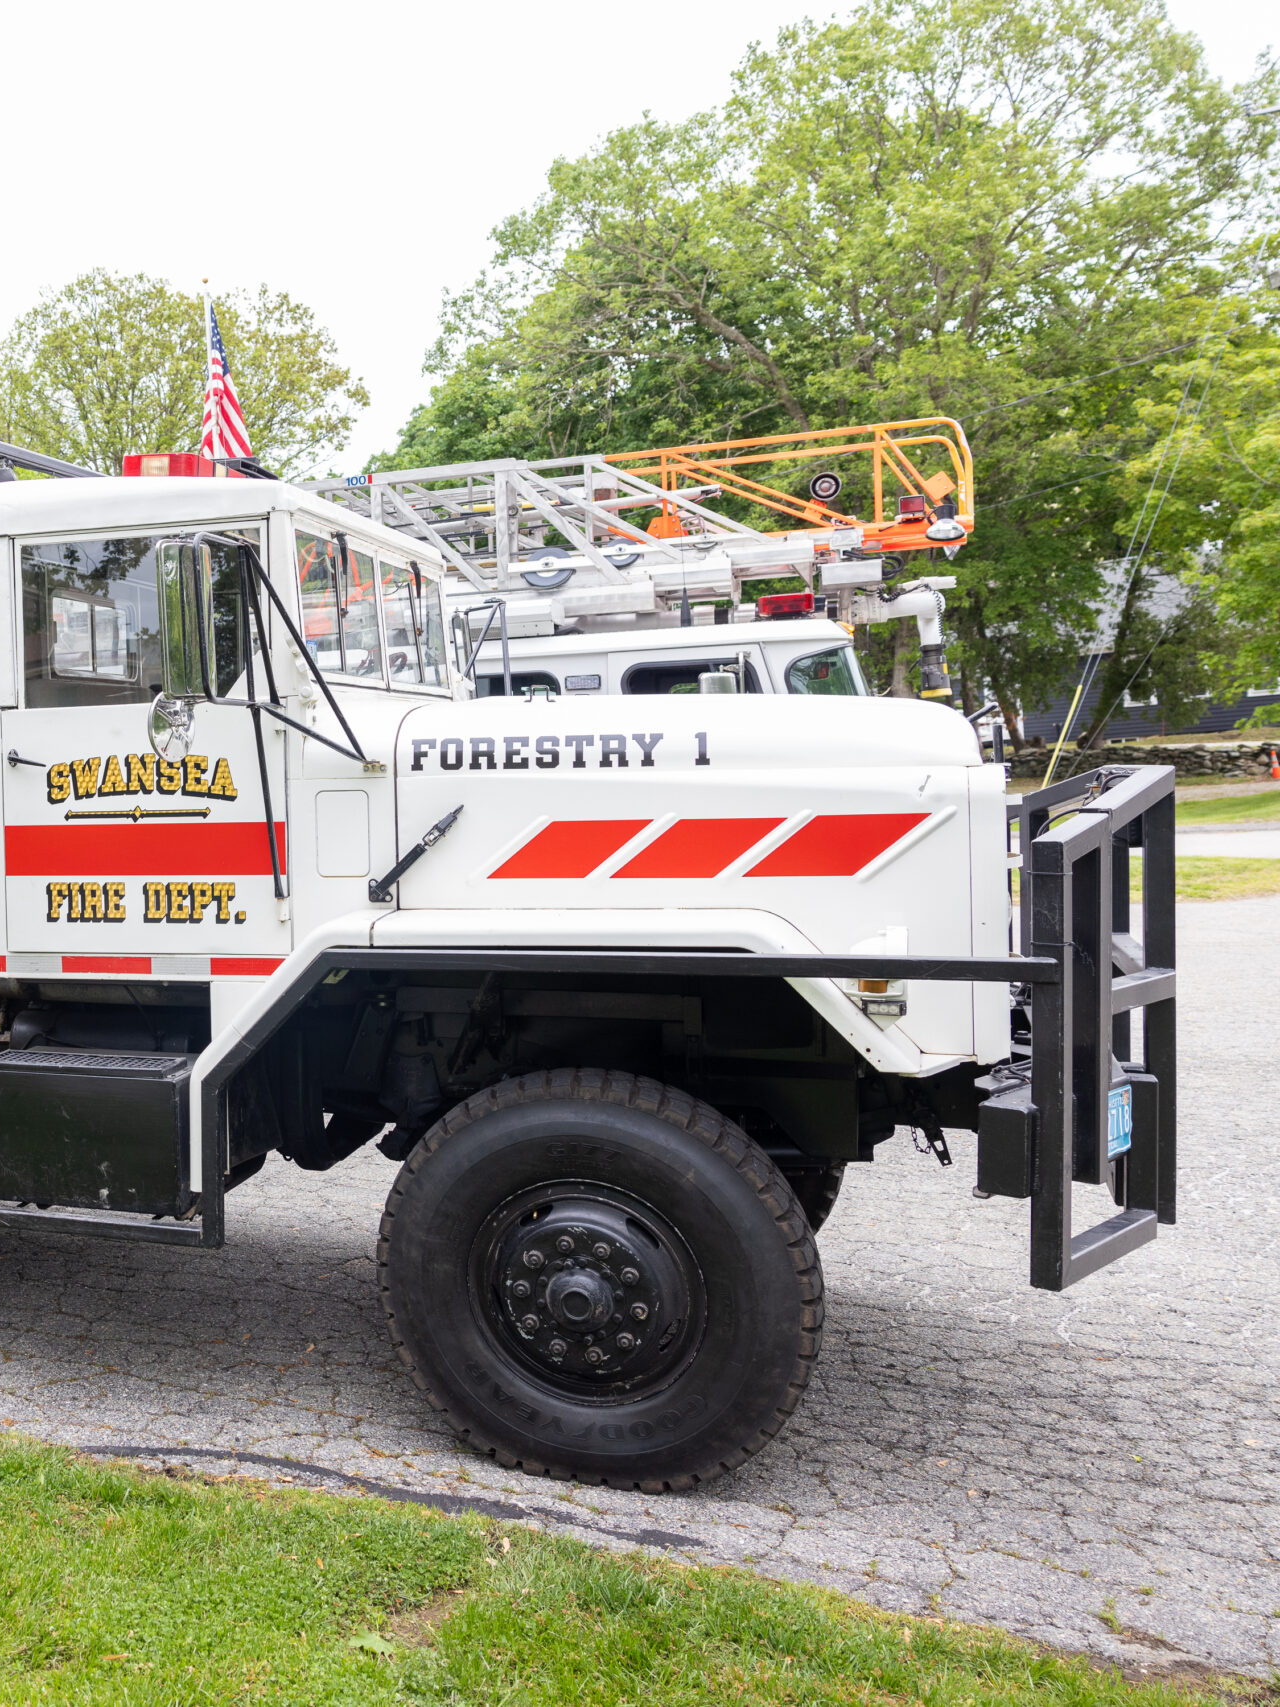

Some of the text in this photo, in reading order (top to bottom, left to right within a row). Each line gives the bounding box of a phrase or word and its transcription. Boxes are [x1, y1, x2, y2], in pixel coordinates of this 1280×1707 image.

[346, 475, 367, 487] 100
[411, 731, 711, 771] FORESTRY 1
[47, 752, 238, 804] SWANSEA
[46, 881, 247, 925] FIRE DEPT.
